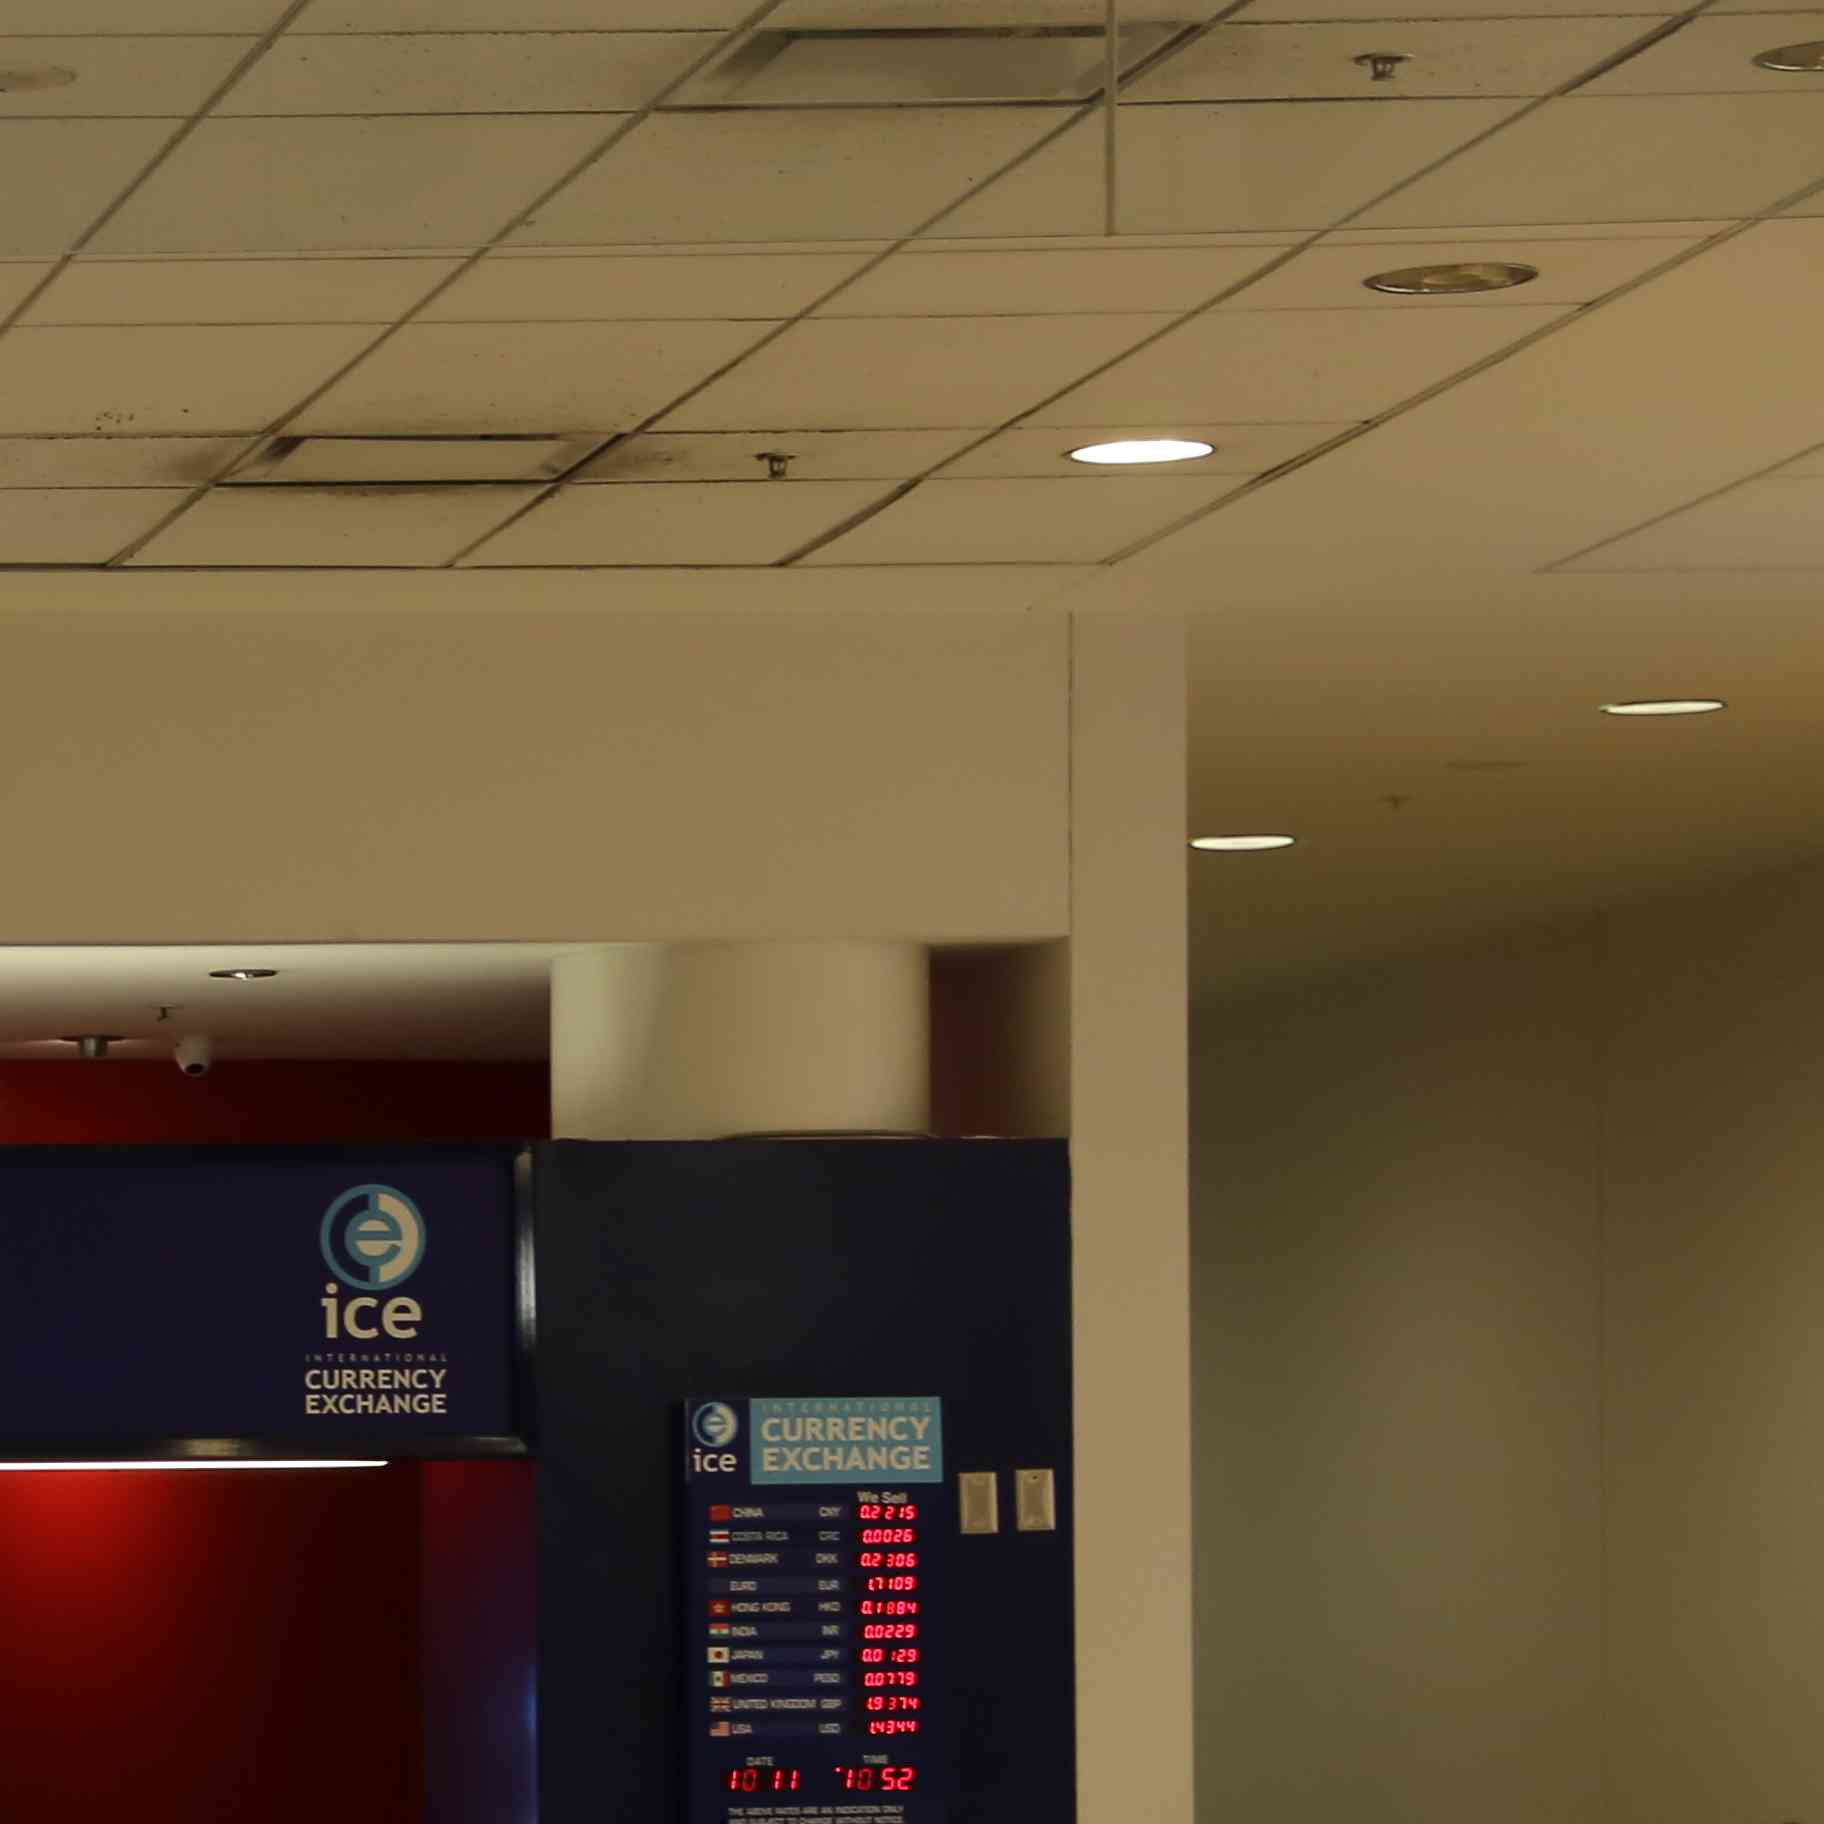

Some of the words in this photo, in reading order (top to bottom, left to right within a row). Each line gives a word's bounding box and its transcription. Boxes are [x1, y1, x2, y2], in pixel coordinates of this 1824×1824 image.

[321, 1283, 423, 1340] ice
[305, 1353, 448, 1363] INTERNATIONAL
[305, 1368, 448, 1390] CURRENCY
[305, 1393, 448, 1415] EXCHANGE
[761, 1416, 931, 1442] CURRENCY
[692, 1448, 737, 1473] ice
[762, 1446, 932, 1472] EXCHANGE
[857, 1491, 879, 1503] We
